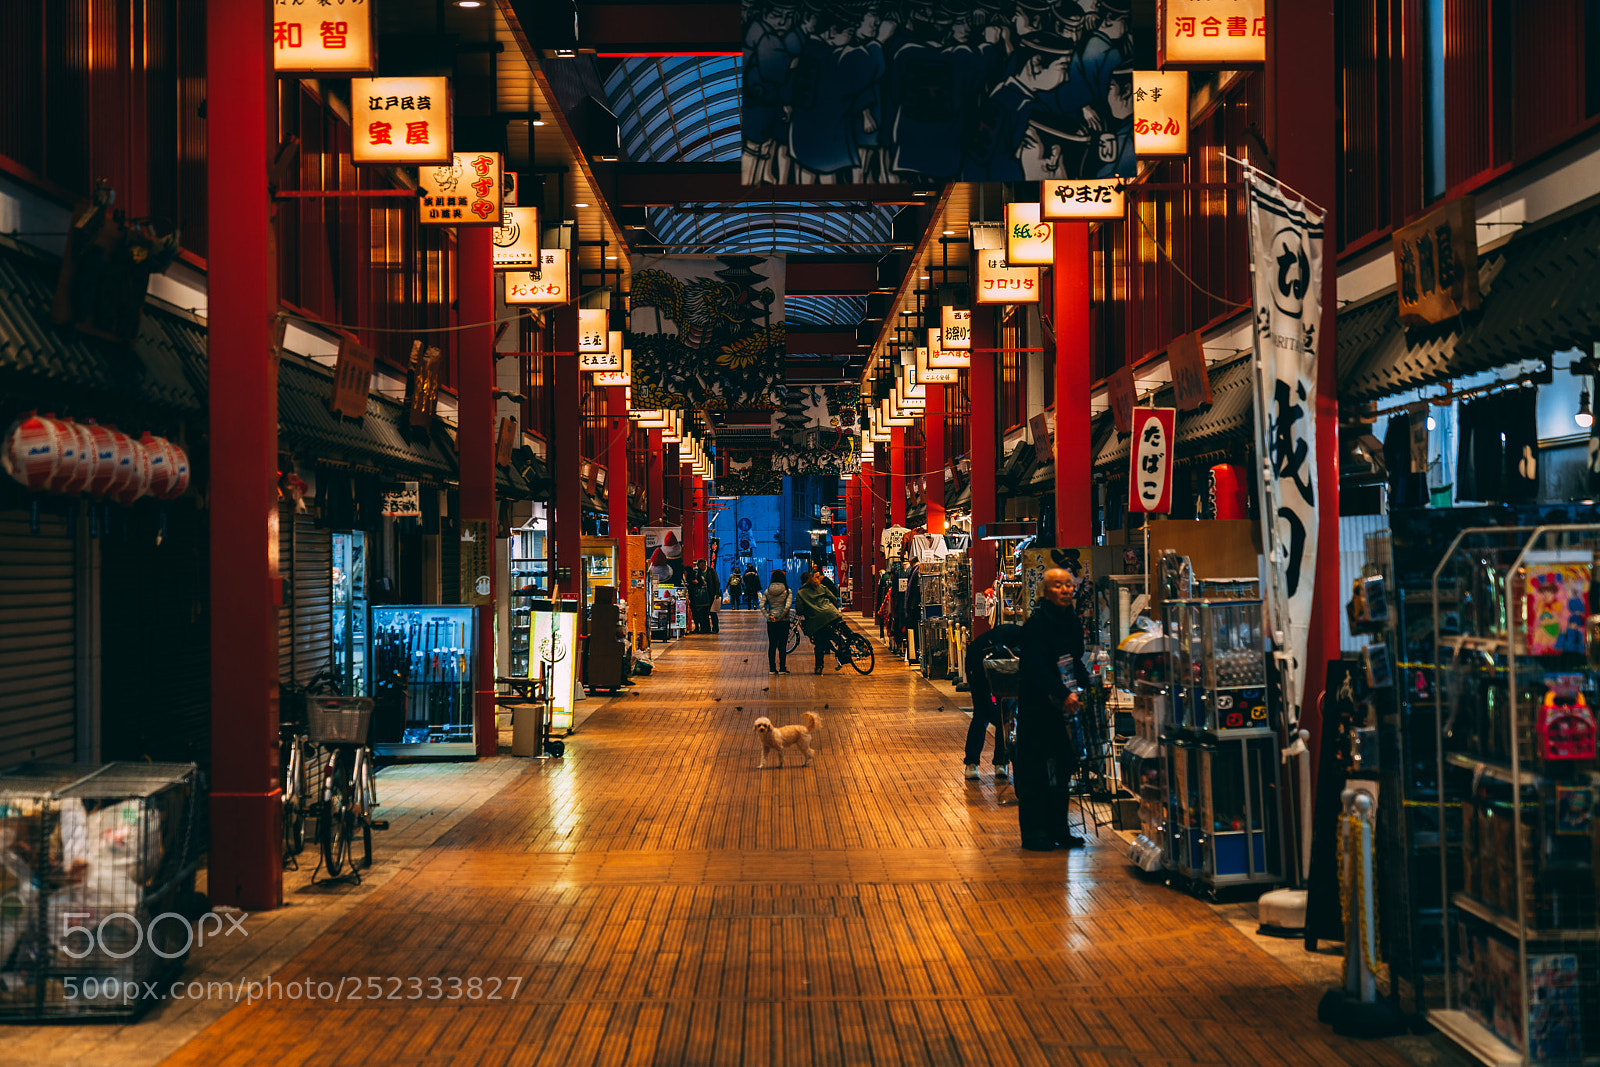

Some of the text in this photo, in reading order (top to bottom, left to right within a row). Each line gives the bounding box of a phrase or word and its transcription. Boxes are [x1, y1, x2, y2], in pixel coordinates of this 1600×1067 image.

[274, 20, 347, 49] 和智
[1175, 16, 1265, 38] 河合書店
[368, 95, 431, 111] 江戸民芸
[368, 121, 430, 146] 宝屋
[471, 154, 494, 219] すずや
[1054, 185, 1114, 204] やまだ
[511, 283, 561, 297] おがわ
[1142, 426, 1165, 500] たばこ
